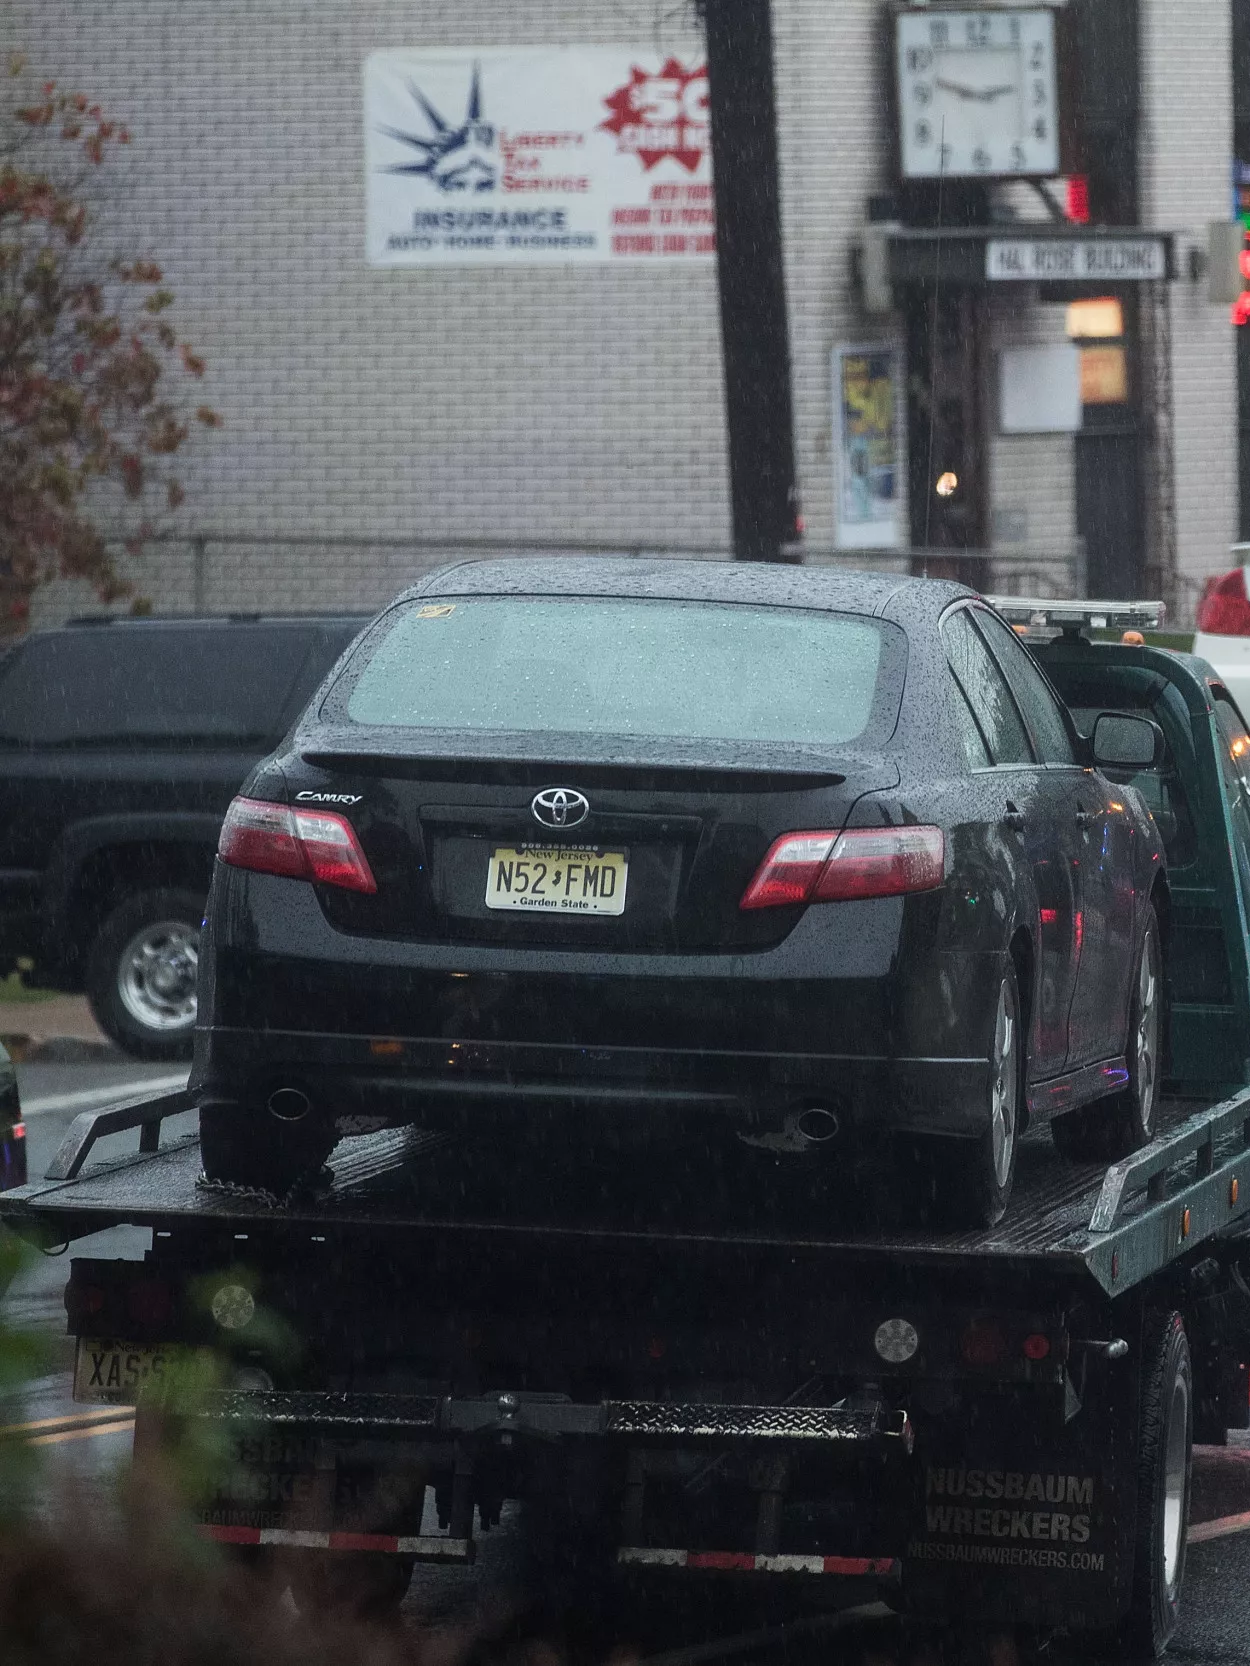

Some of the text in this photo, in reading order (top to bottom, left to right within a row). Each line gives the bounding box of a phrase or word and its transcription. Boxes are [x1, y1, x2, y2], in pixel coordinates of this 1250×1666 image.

[412, 208, 570, 231] INSURANCE
[525, 849, 594, 863] New Jersey
[520, 896, 589, 910] Garden State
[927, 1466, 1094, 1505] NUSSBAUM
[926, 1504, 1091, 1543] WRECKERS
[907, 1541, 1105, 1571] NUSSBAUMWRECKERS.COM
